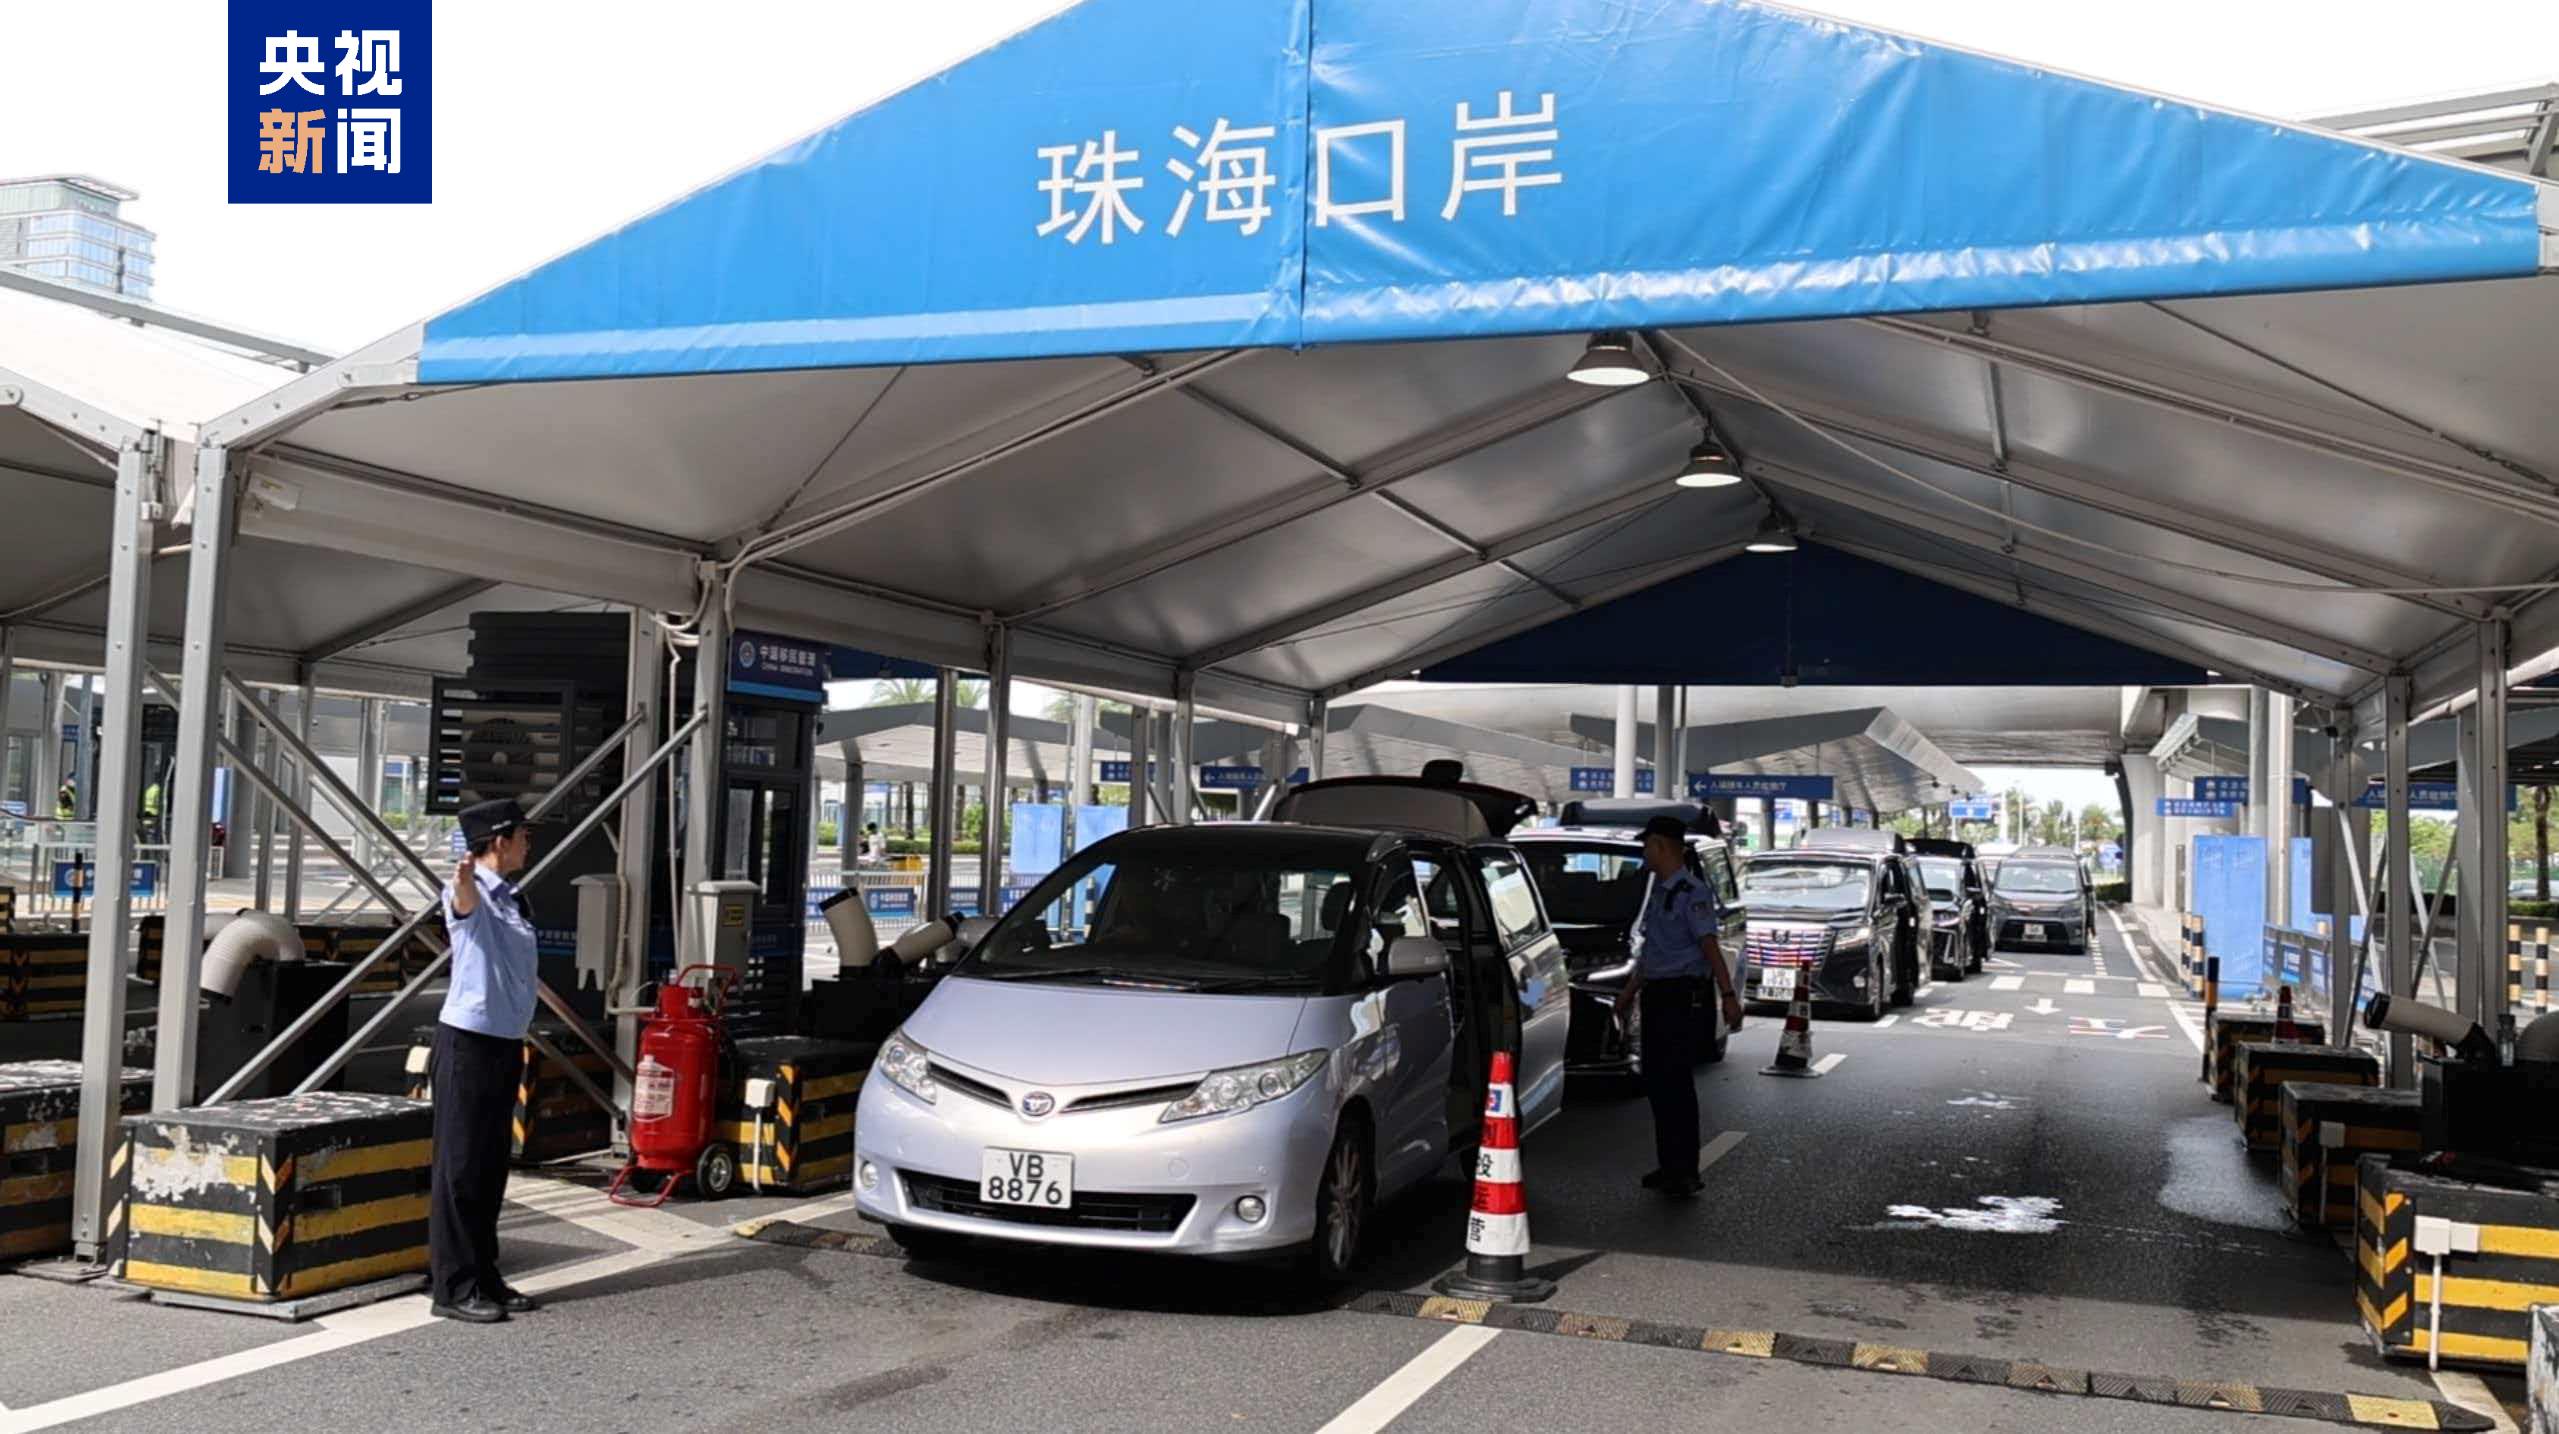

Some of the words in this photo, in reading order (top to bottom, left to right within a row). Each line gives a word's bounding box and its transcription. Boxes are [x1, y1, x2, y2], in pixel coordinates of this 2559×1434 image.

[1036, 90, 1563, 246] 珠海口岸
[1009, 1153, 1044, 1178] VB
[988, 1176, 1063, 1205] 8876
